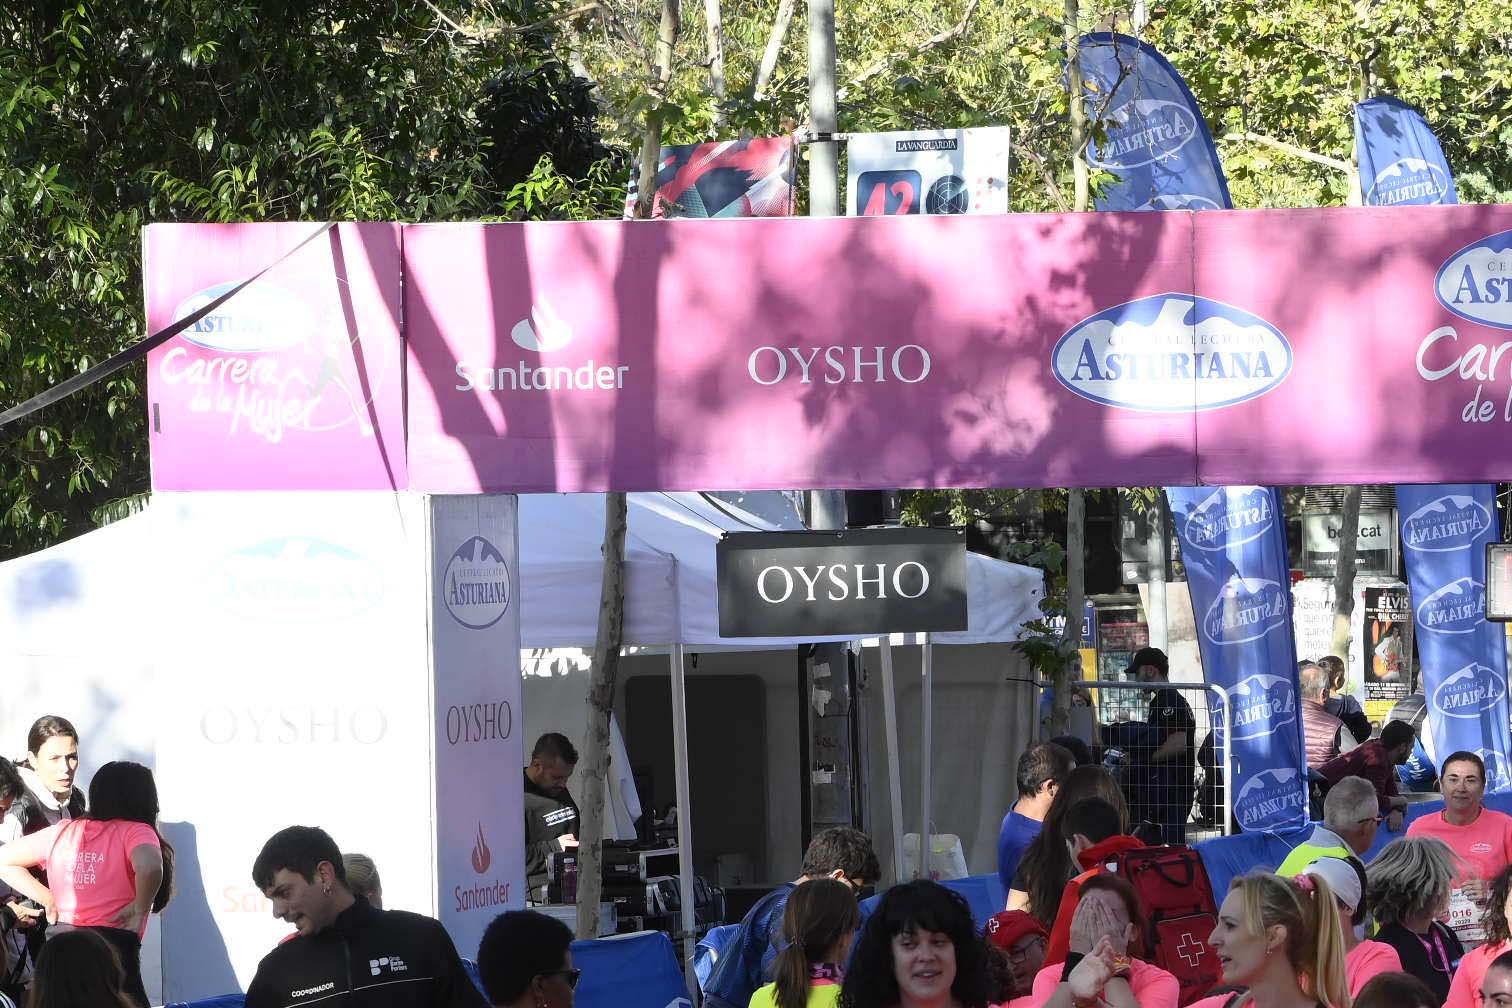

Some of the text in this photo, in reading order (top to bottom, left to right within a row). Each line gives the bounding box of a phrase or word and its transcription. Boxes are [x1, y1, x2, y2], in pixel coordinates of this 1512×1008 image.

[455, 359, 630, 392] Santander
[747, 343, 932, 385] OYSHO
[1070, 337, 1274, 381] ASTURIANA
[1462, 384, 1495, 424] de
[449, 570, 507, 605] ASTURIANA
[757, 561, 930, 603] OYSHO
[1378, 596, 1409, 609] ELVIS
[447, 700, 512, 745] OYSHO
[455, 880, 510, 913] Santander
[1451, 908, 1472, 919] 016
